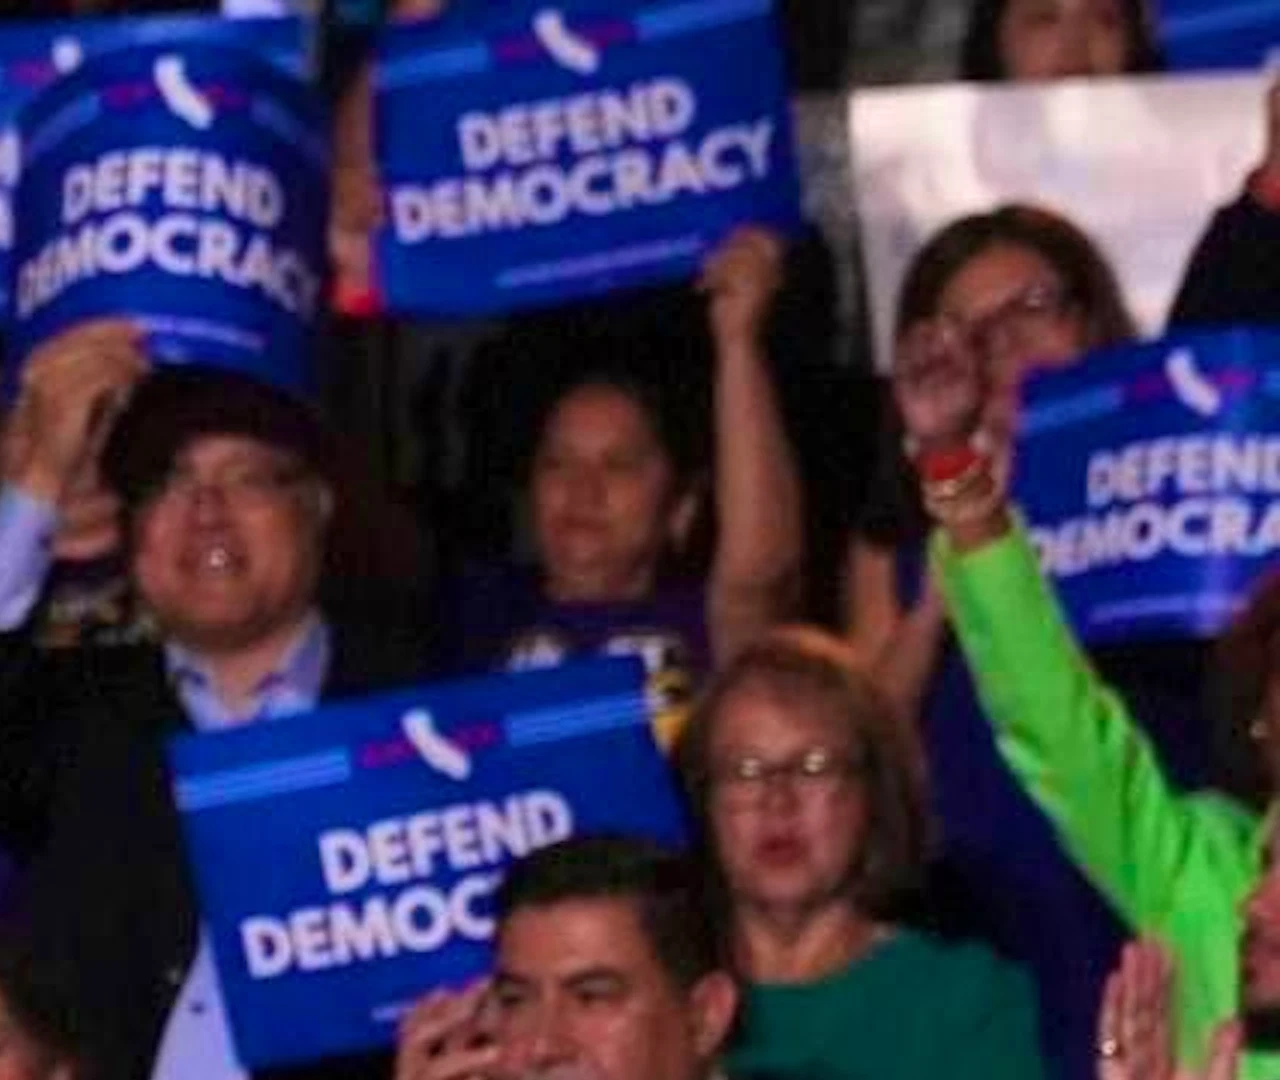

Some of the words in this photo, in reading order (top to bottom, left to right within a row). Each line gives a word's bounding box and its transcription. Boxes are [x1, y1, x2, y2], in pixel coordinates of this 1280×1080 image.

[458, 75, 696, 172] DEFEND
[62, 146, 285, 230] DEFEND
[392, 116, 777, 244] DEMOCRACY
[16, 211, 321, 323] DEMOCRACY
[318, 789, 574, 895] DEFEND
[241, 873, 498, 980] DEMOC
